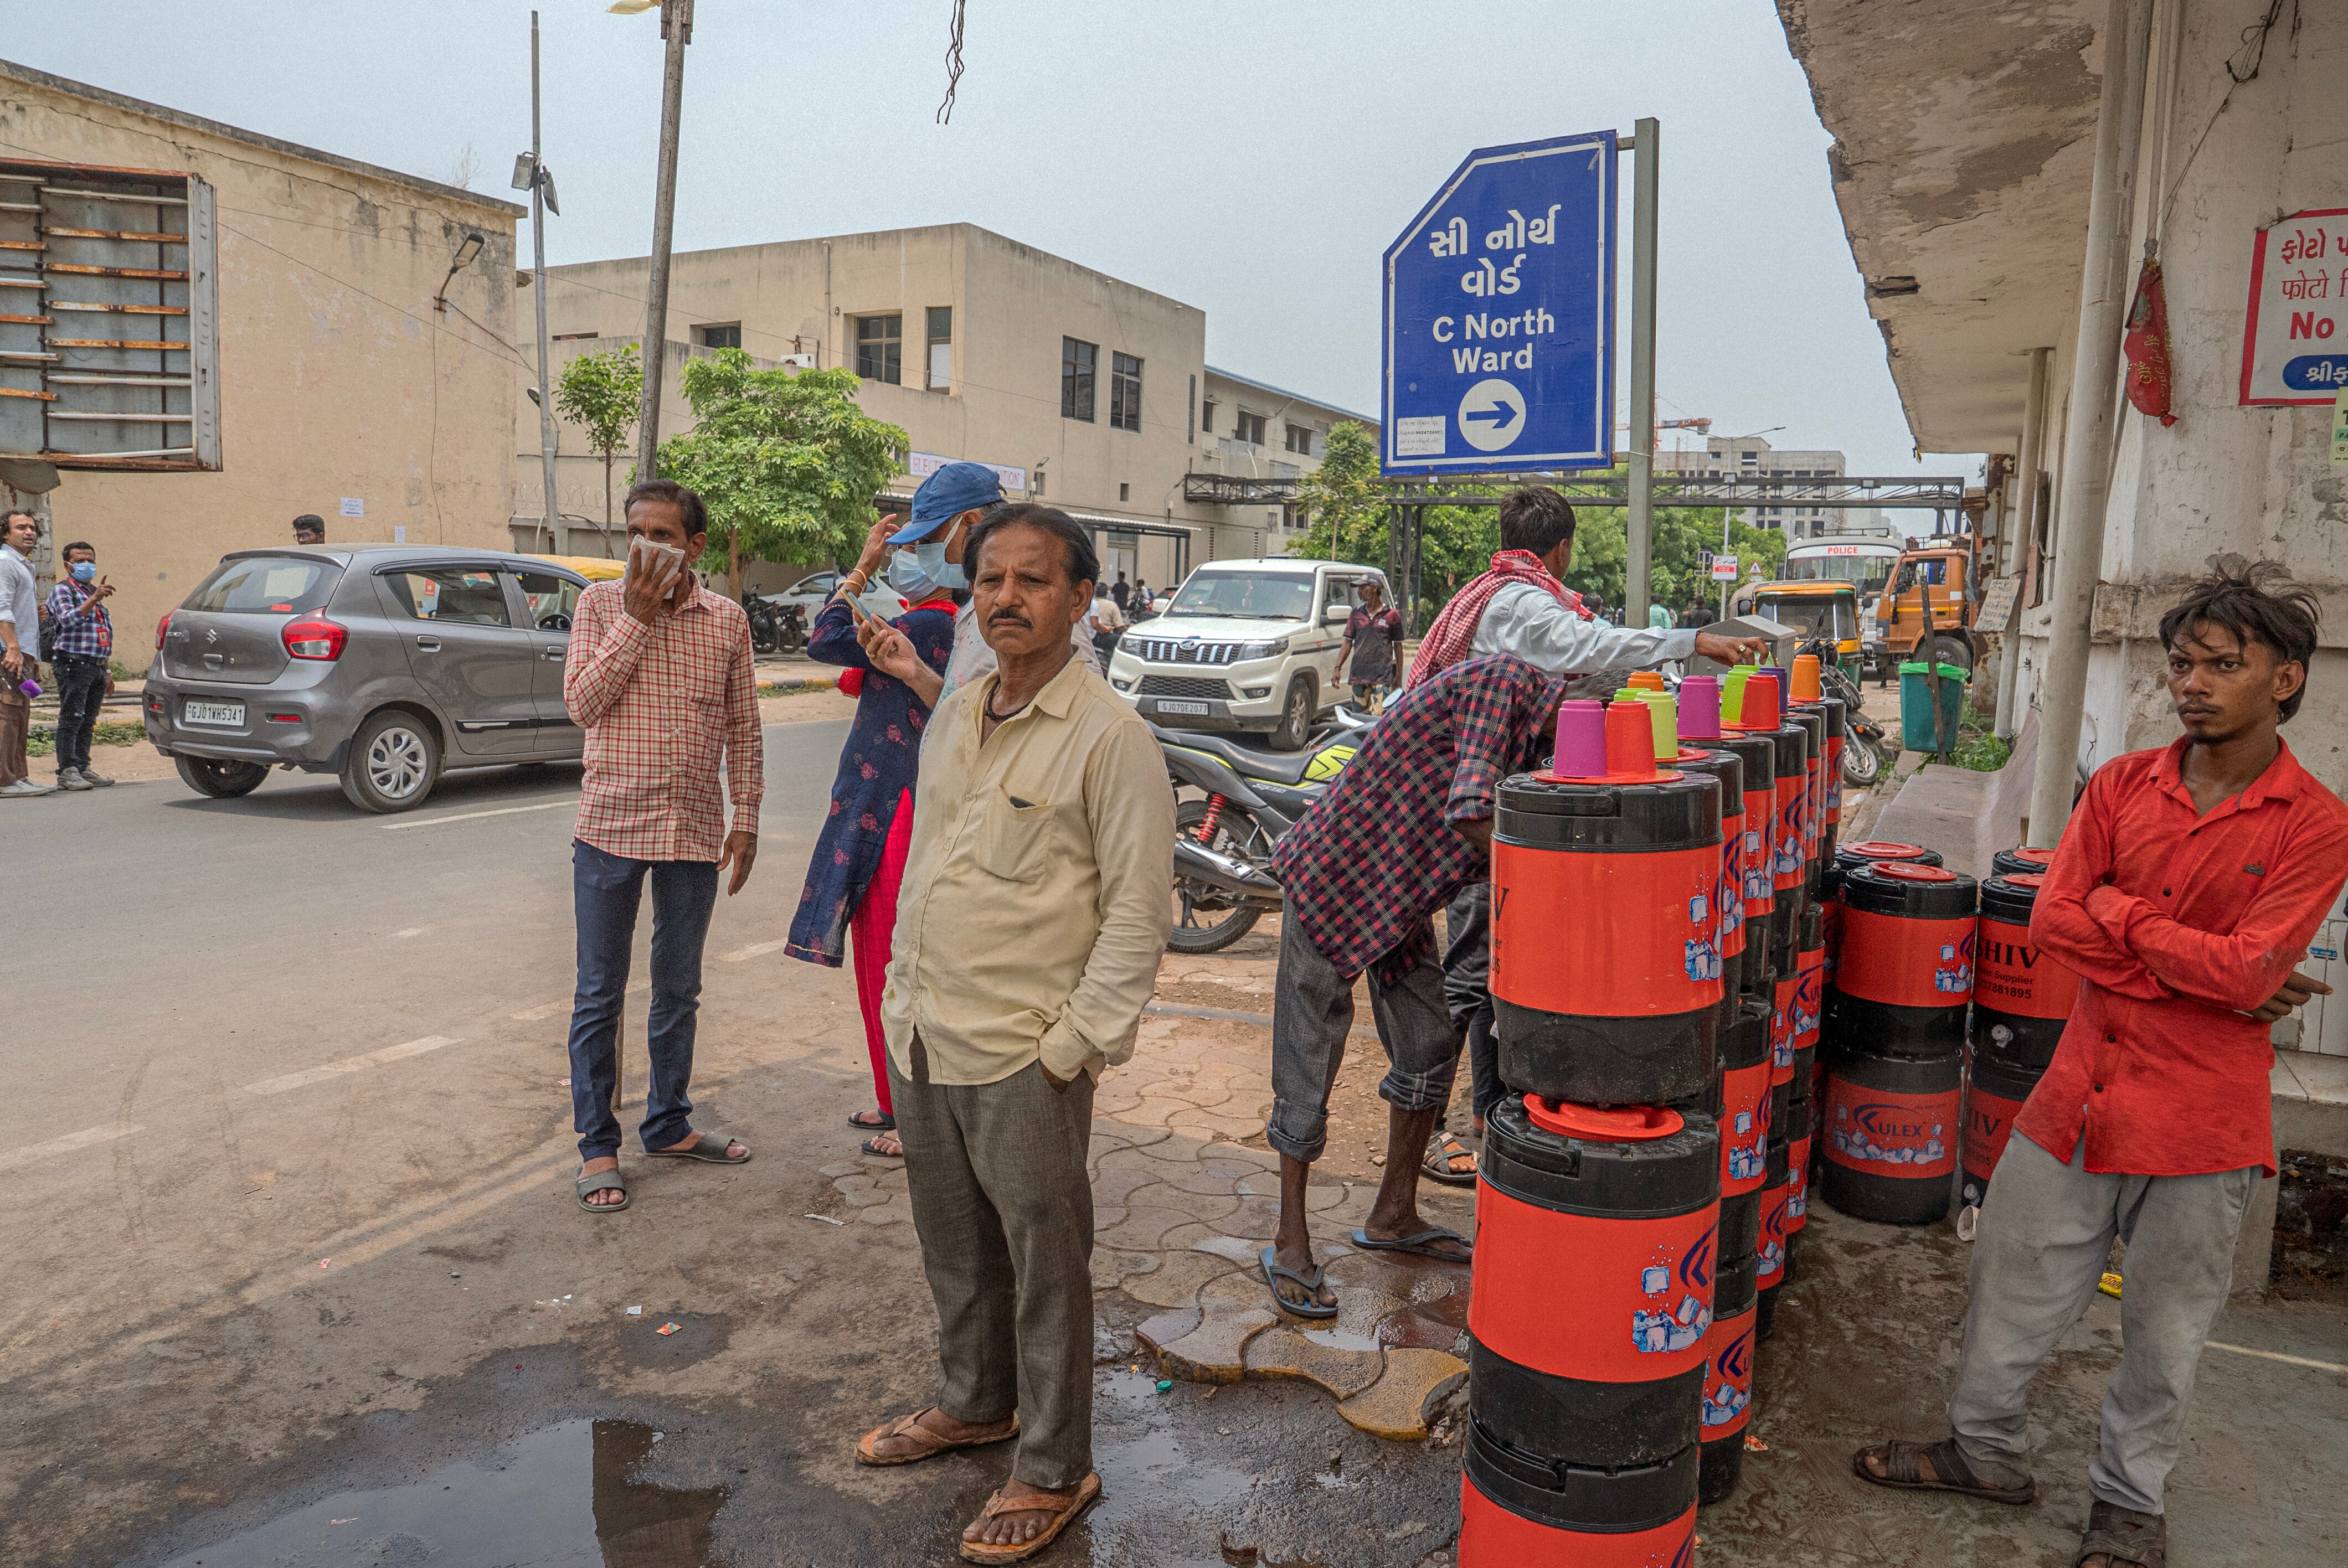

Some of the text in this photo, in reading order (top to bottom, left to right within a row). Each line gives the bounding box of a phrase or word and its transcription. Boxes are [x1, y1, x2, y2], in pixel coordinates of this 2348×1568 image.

[1429, 204, 1561, 257] સી નોર્થ
[2281, 228, 2326, 264] ફોટો
[1461, 254, 1527, 297] વોર્ડ
[2281, 269, 2330, 300] फोटो
[1433, 308, 1554, 343] C North
[2289, 311, 2335, 339] No
[1452, 342, 1533, 374] Ward
[2305, 361, 2348, 384] શ્રીફ
[192, 706, 242, 721] GJ01WH5341
[1163, 703, 1207, 713] GJ07DE2077
[1976, 936, 2041, 969] SHIV
[1994, 969, 2035, 985] Supplier
